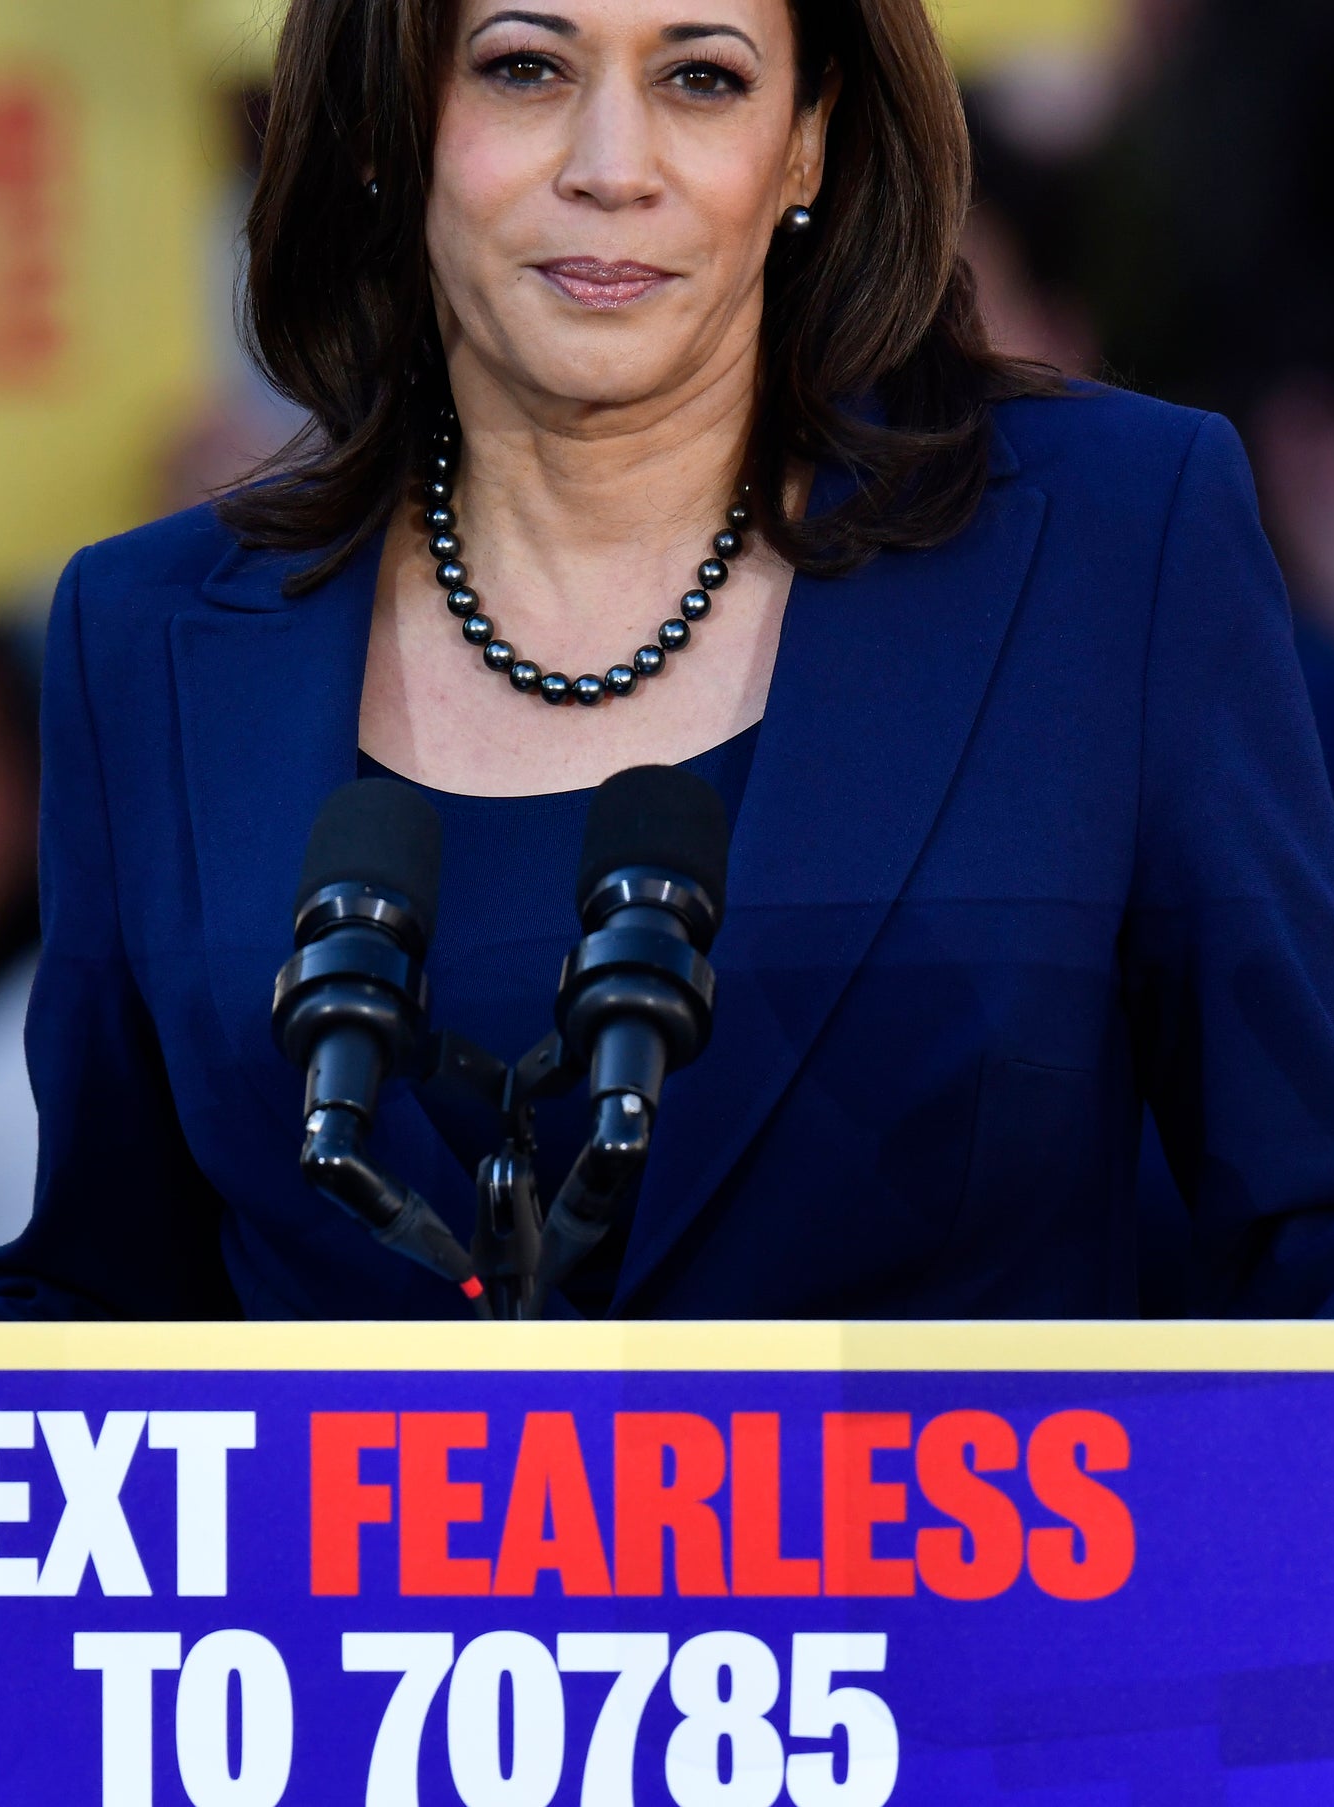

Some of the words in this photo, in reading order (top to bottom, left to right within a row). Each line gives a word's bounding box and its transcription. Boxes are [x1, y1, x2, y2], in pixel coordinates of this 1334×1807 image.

[310, 1408, 1137, 1602] FEARLESS
[73, 1628, 295, 1807] TO
[341, 1629, 900, 1807] 70785
